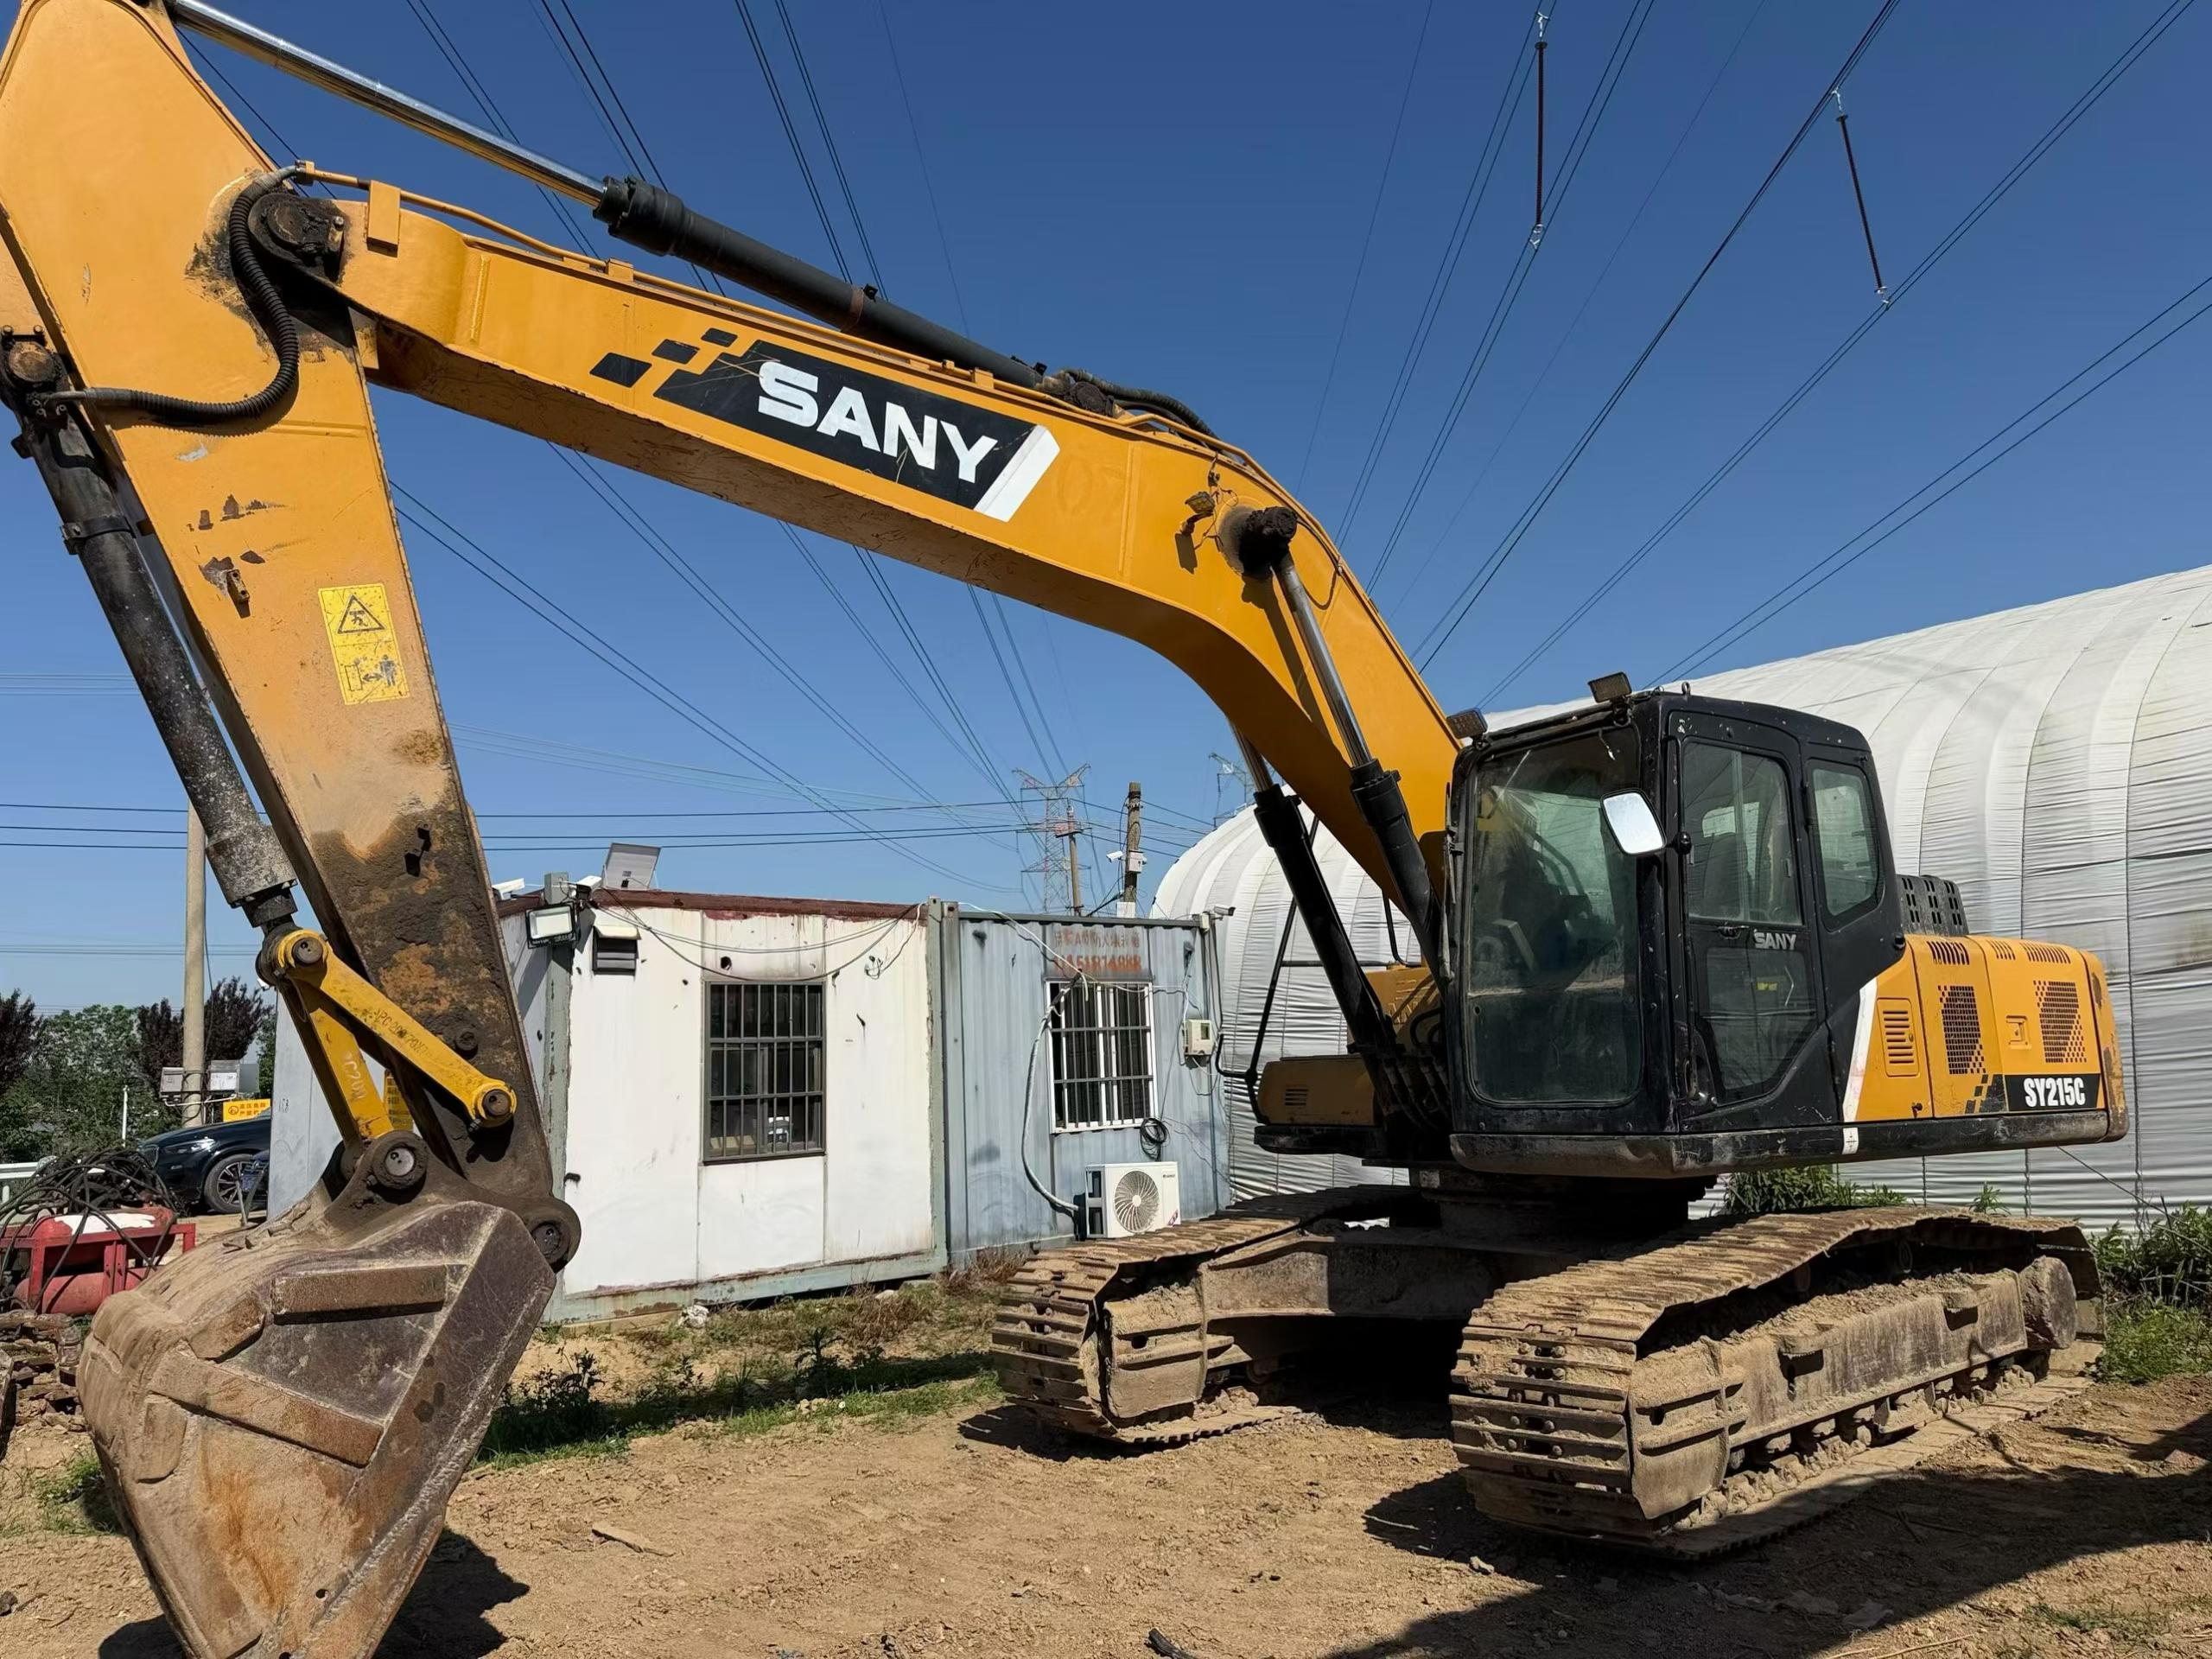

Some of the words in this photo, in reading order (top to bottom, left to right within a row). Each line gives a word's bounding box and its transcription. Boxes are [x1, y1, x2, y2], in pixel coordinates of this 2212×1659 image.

[758, 361, 998, 484] SANY
[1754, 932, 1796, 950] SANY
[2024, 1077, 2086, 1107] SY215C
